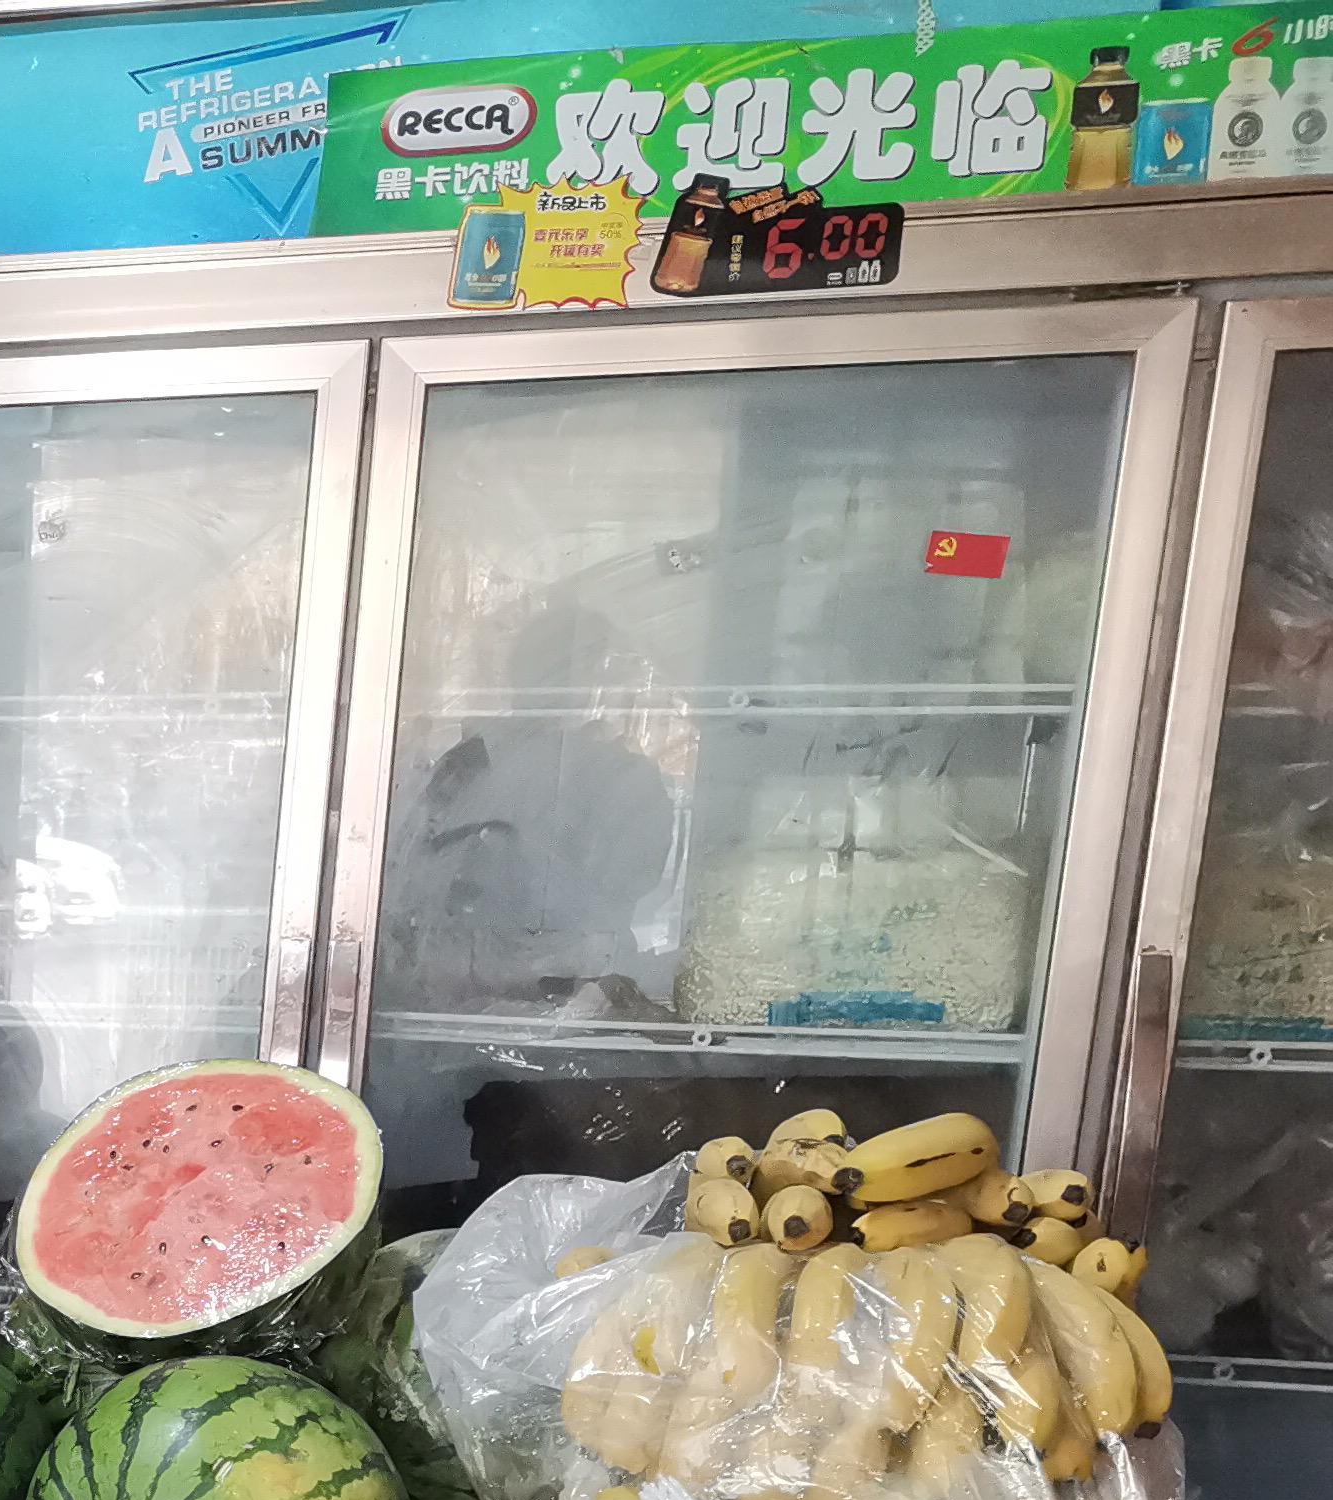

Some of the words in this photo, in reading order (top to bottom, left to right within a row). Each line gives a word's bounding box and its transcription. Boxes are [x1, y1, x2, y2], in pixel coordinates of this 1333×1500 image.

[1232, 17, 1278, 57] 6
[138, 75, 324, 132] REFRIGERA
[165, 69, 233, 101] THE
[204, 110, 290, 138] PIONEER
[397, 103, 515, 136] RECCA
[546, 64, 1052, 194] 欢迎光临
[143, 128, 193, 183] A
[200, 126, 322, 171] SUMM
[375, 158, 529, 200] 黑卡饮料
[537, 191, 608, 212] 新品上市
[763, 212, 889, 280] 6.00
